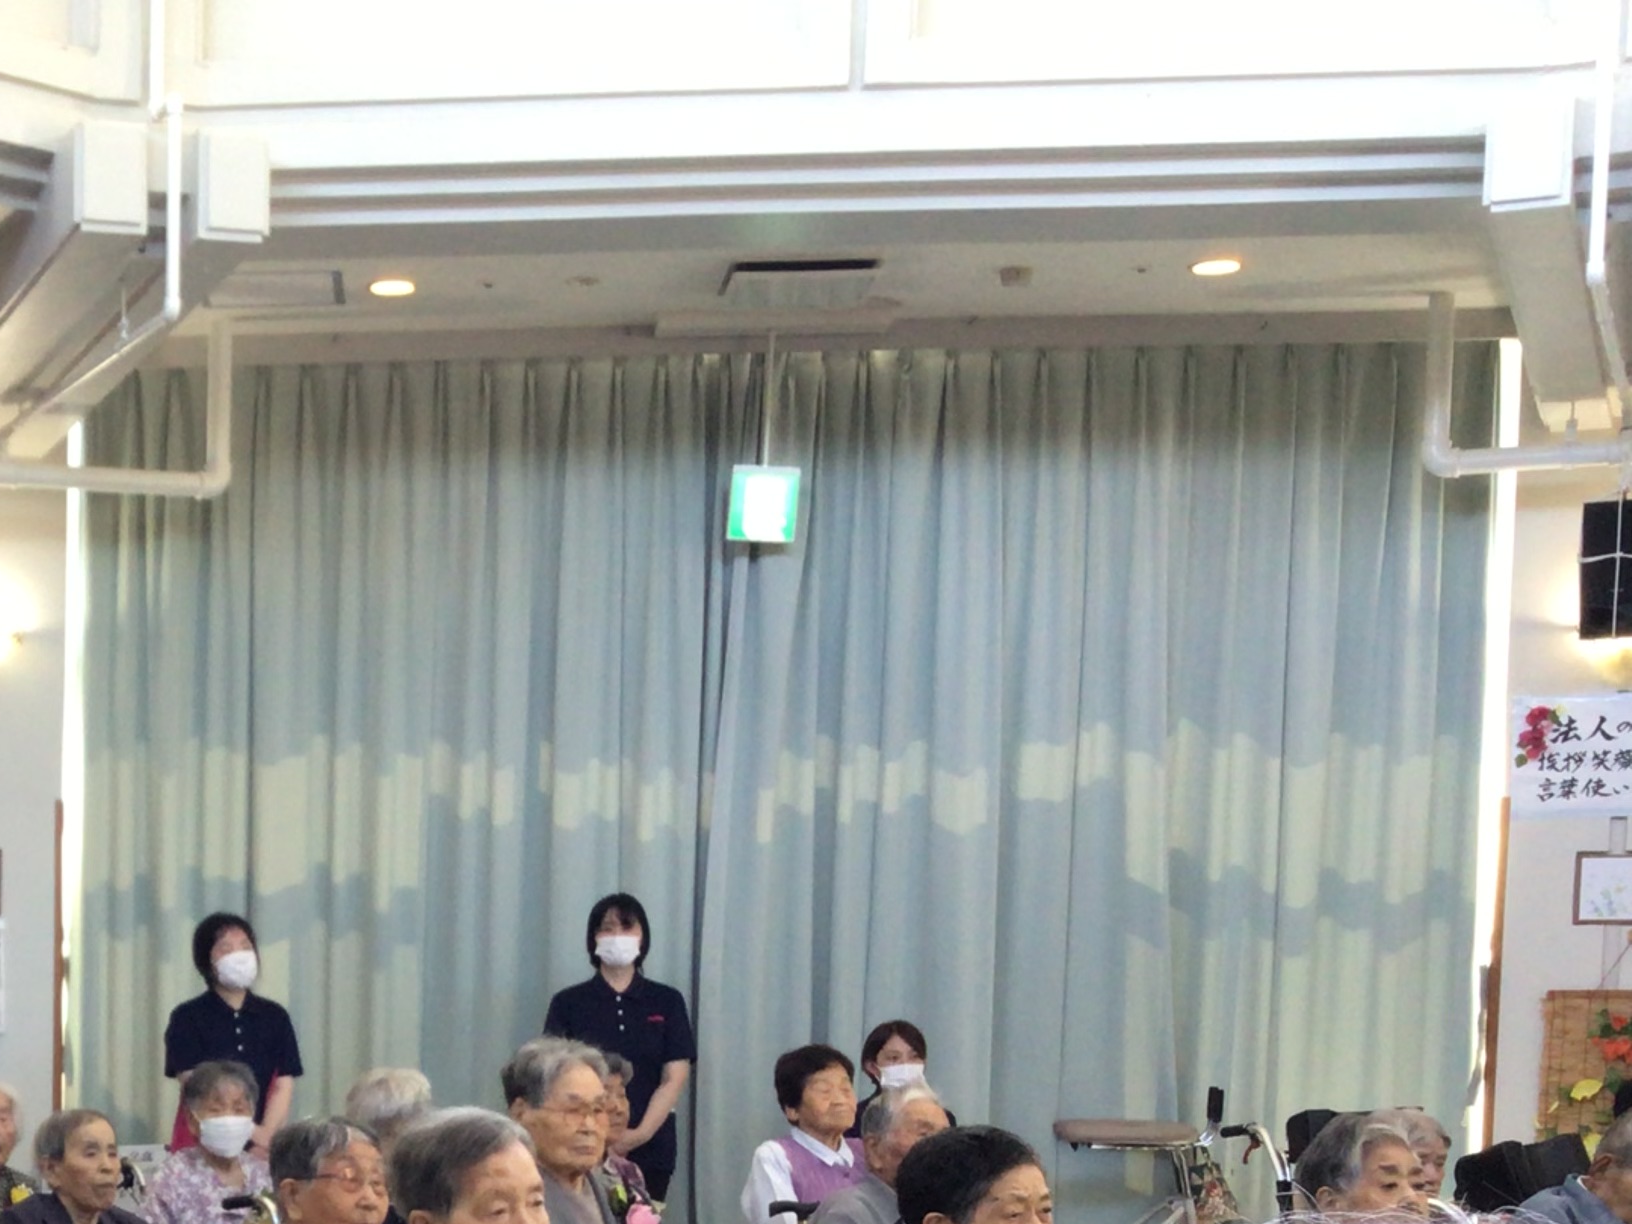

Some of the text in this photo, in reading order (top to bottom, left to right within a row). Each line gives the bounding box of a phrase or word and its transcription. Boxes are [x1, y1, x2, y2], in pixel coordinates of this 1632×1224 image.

[1550, 715, 1632, 744] 法人の
[1536, 776, 1630, 802] 言葉使い
